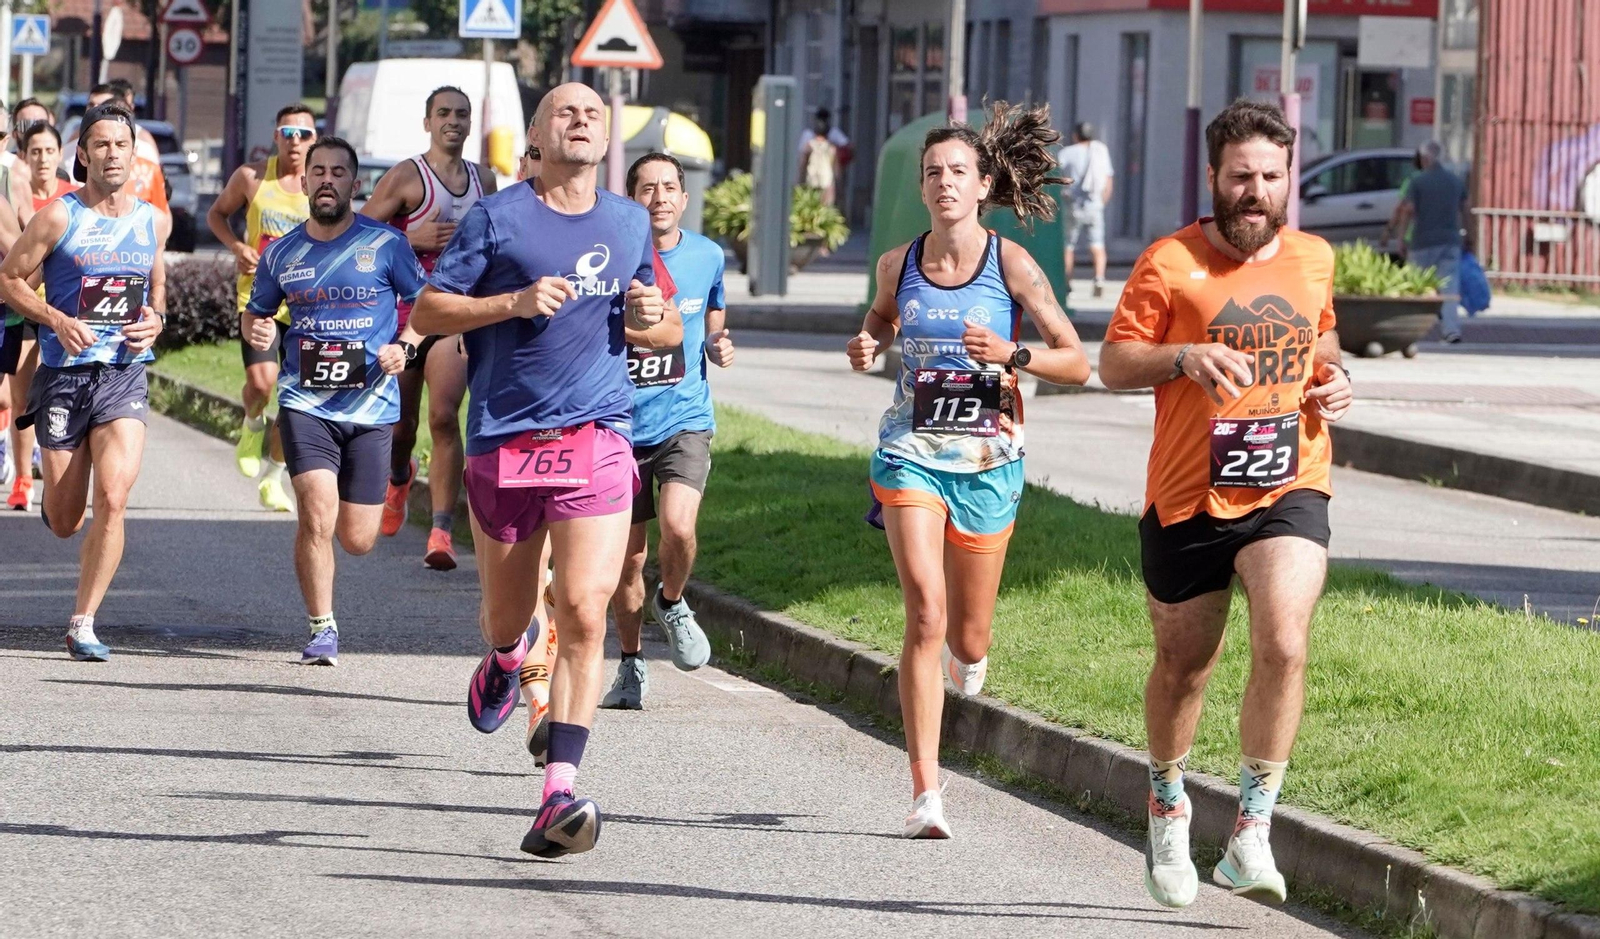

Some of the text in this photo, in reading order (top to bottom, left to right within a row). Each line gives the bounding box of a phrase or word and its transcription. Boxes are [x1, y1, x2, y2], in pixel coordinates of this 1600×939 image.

[171, 37, 197, 53] 30
[74, 251, 154, 267] MECADOBA
[280, 269, 313, 283] DISMAC
[93, 297, 129, 317] 44
[318, 317, 373, 331] TORVIGO
[1207, 324, 1313, 350] TRAIL DO
[313, 362, 350, 381] 58
[628, 354, 673, 379] 281
[1211, 336, 1310, 388] URÉS
[932, 397, 982, 422] 113
[1213, 423, 1229, 435] 20
[1254, 426, 1275, 435] CAE
[517, 449, 574, 475] 765
[1221, 446, 1292, 476] 223
